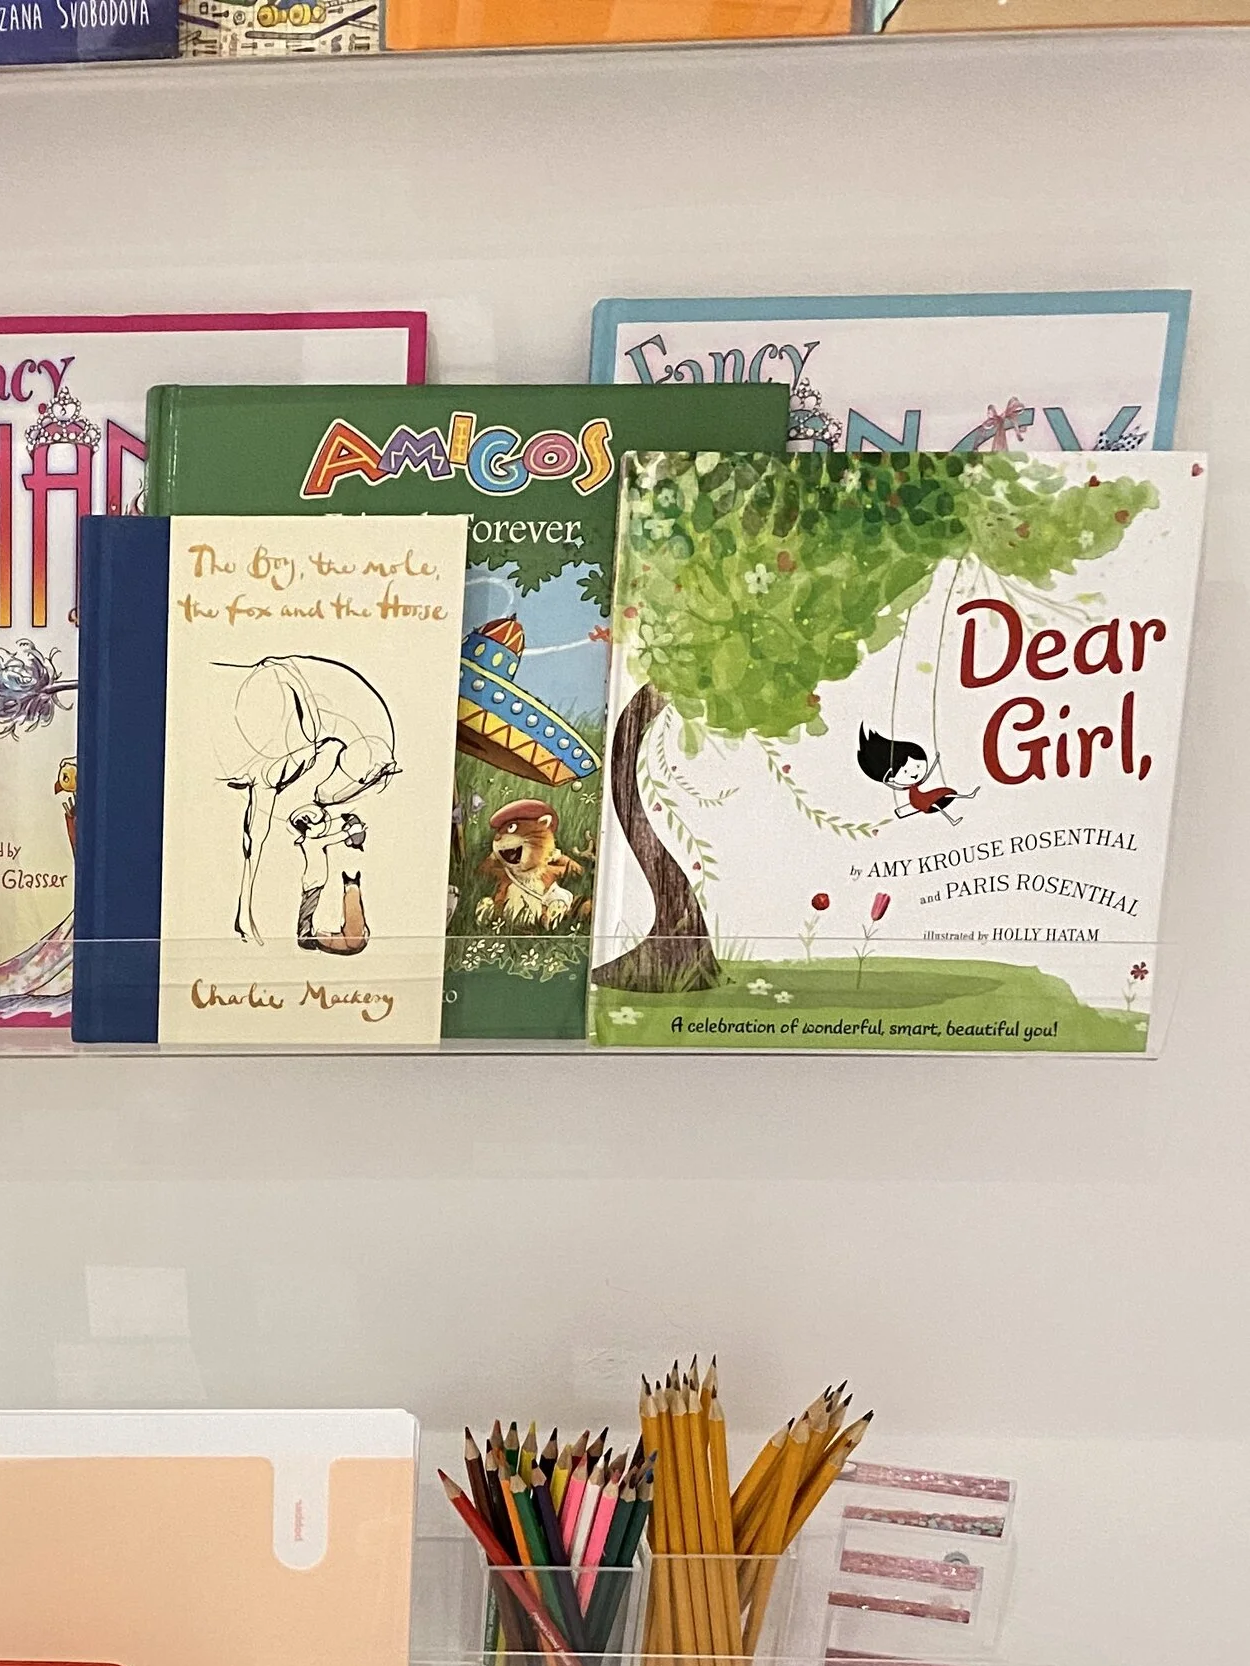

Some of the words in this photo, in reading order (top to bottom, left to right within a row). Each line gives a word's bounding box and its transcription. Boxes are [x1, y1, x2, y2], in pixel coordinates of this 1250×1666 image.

[300, 412, 614, 499] AMIGOS
[188, 543, 236, 578] The
[247, 543, 304, 591] Boy,
[309, 551, 356, 576] the
[362, 548, 440, 581] mole,
[177, 593, 219, 623] the
[225, 593, 272, 627] fox
[280, 600, 325, 620] and
[330, 592, 372, 620] the
[376, 579, 448, 621] Horse
[956, 598, 1167, 689] Dear
[982, 690, 1152, 786] Girl,
[7, 842, 22, 860] by
[850, 865, 863, 881] by
[867, 859, 913, 878] AMY
[917, 839, 1005, 875] KROUSE
[1010, 827, 1138, 852] ROSENTHAL
[1, 869, 68, 890] Glasser
[919, 890, 941, 905] and
[945, 874, 1010, 900] PARIS
[1016, 873, 1140, 918] ROSENTHAL
[923, 928, 975, 942] illustrated
[977, 930, 989, 942] by
[992, 928, 1042, 942] HOLLY
[1046, 928, 1099, 942] HATAM
[191, 978, 284, 1010] Charlie
[671, 1016, 684, 1033] A
[687, 1017, 776, 1034] celebration
[780, 1018, 800, 1035] of
[802, 1019, 885, 1037] wonderful,
[889, 1021, 942, 1038] smart,
[946, 1020, 1019, 1037] beautiful
[1022, 1021, 1058, 1042] you!
